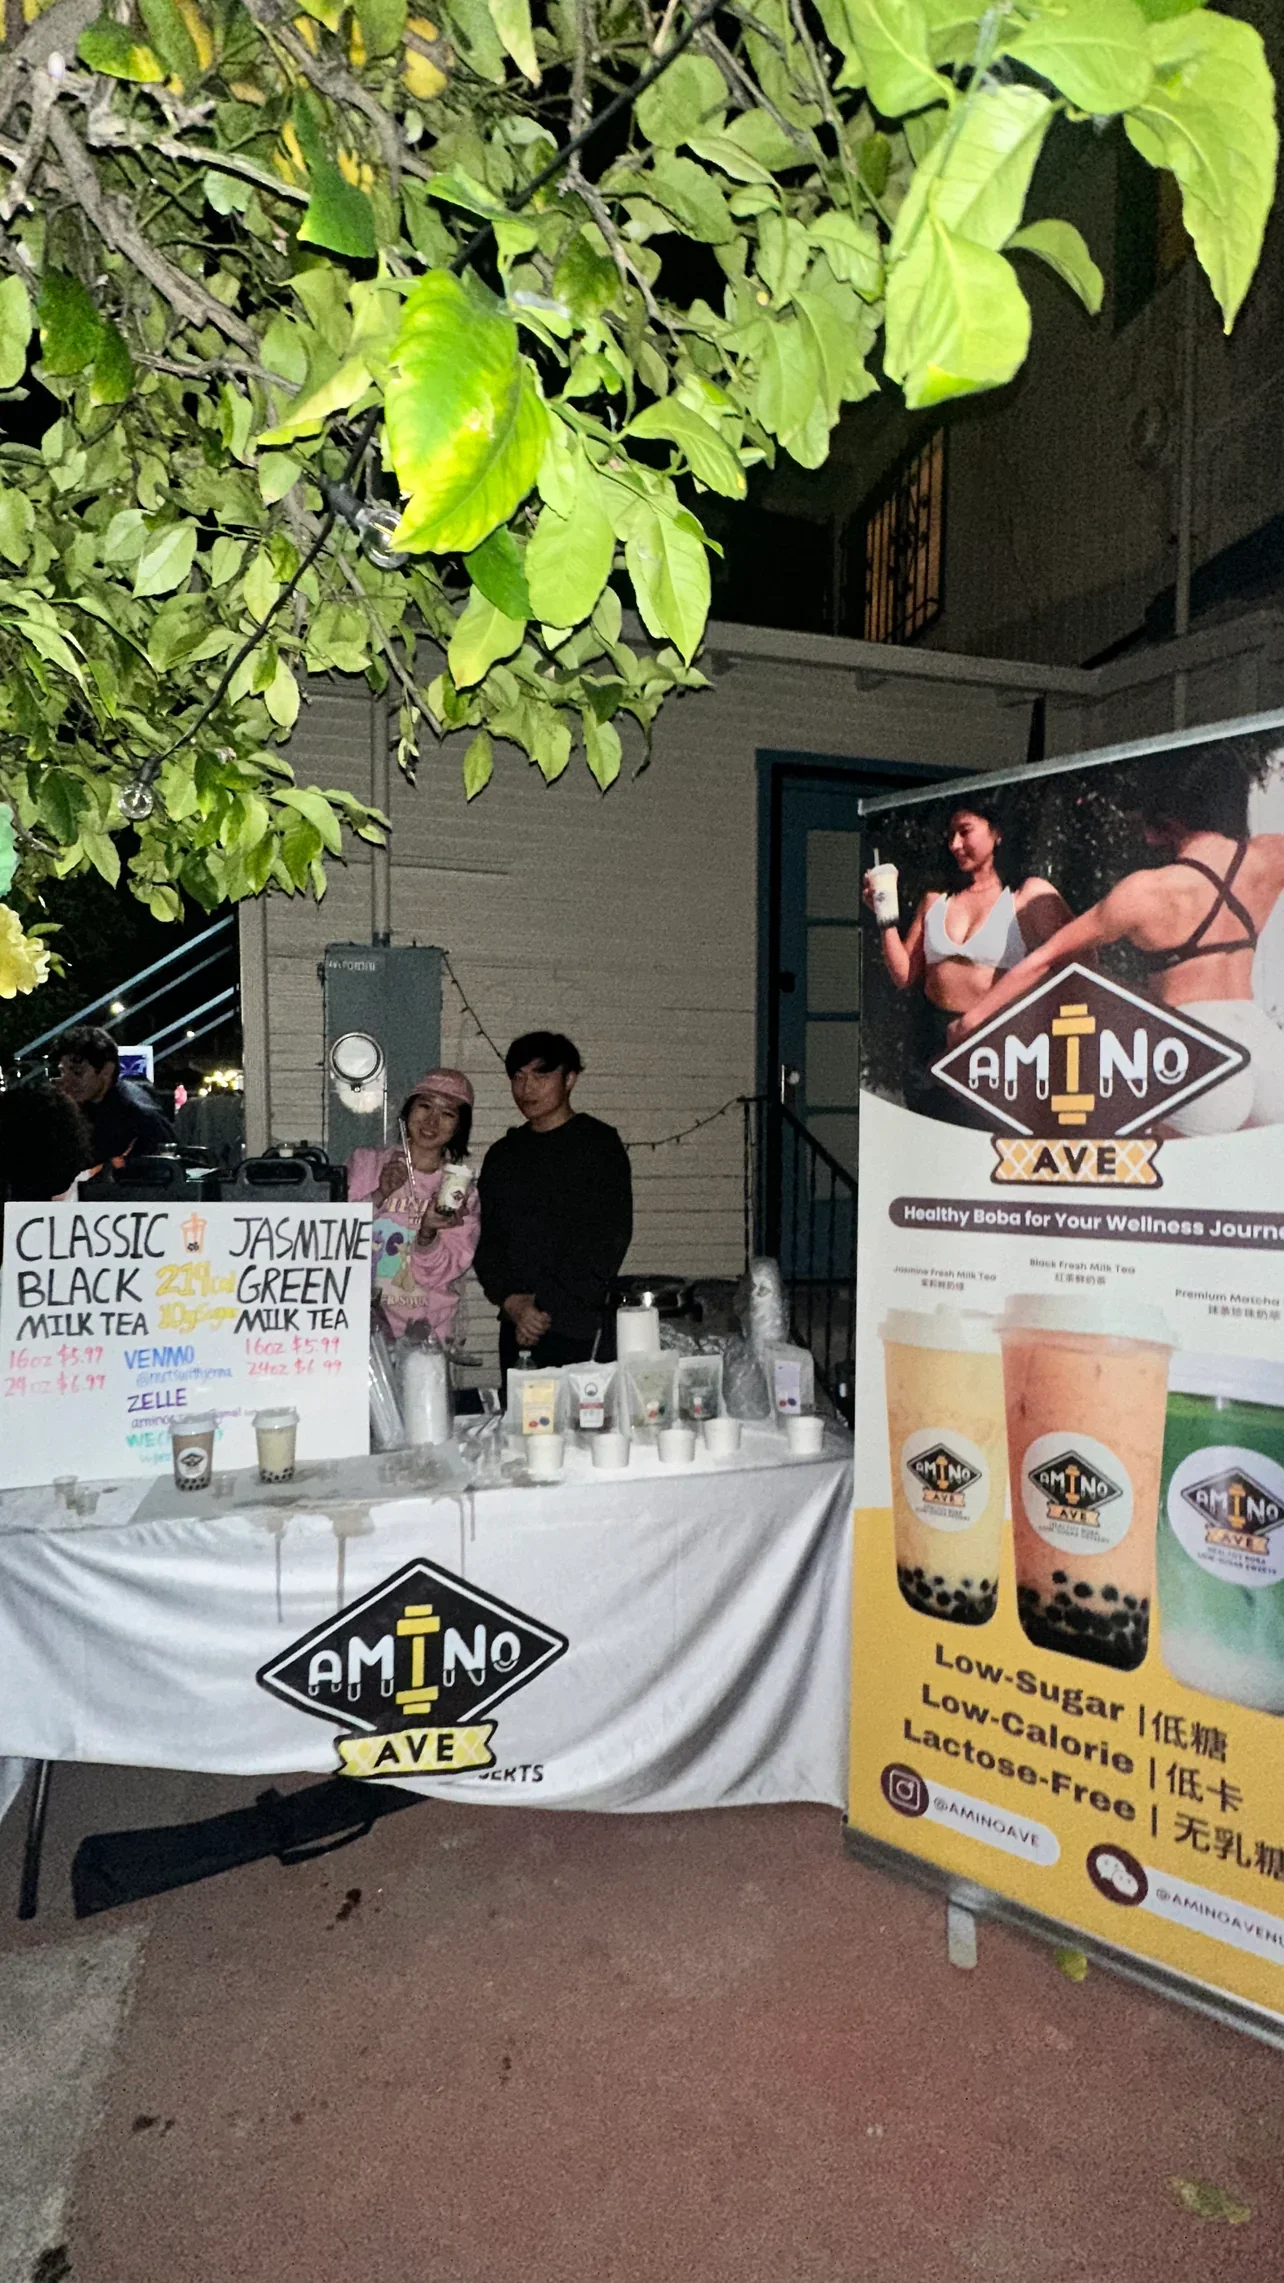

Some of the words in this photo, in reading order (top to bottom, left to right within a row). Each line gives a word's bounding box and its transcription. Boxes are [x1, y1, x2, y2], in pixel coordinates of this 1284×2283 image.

[968, 1003, 1190, 1125] AMINO
[1033, 1146, 1116, 1175] AVE
[16, 1212, 169, 1262] CLASSIC
[904, 1206, 970, 1227] Healthy
[974, 1209, 1021, 1226] Boba
[1025, 1211, 1051, 1228] for
[1054, 1212, 1102, 1231] Your
[1106, 1214, 1204, 1236] Wellness
[229, 1217, 372, 1261] JASMINE
[893, 1266, 929, 1276] Jasmine
[930, 1268, 955, 1278] Fresh
[957, 1271, 976, 1280] Milk
[979, 1272, 997, 1281] Tea
[1029, 1258, 1056, 1268] Black
[1059, 1261, 1087, 1270] Fresh
[1089, 1263, 1112, 1273] Milk
[1116, 1264, 1136, 1275] Tea
[17, 1267, 143, 1308] BLACK
[236, 1264, 352, 1305] GREEN
[1175, 1288, 1227, 1301] Premium
[1230, 1293, 1280, 1306] Matcha
[16, 1312, 94, 1341] MILK
[100, 1312, 149, 1336] TEA
[233, 1308, 300, 1335] MILK
[307, 1308, 349, 1331] TEA
[9, 1347, 53, 1369] 16oz
[124, 1345, 195, 1370] VENMO
[245, 1337, 287, 1356] 16oz
[127, 1388, 187, 1413] ZELLE
[1040, 1464, 1108, 1505] AMINO
[1060, 1511, 1087, 1521] AVE
[1196, 1483, 1279, 1528] AMINO
[1222, 1534, 1254, 1548] AVE
[308, 1604, 521, 1714] AMINO
[934, 1642, 1125, 1723] Low-Sugar
[1151, 1709, 1228, 1763] 低糖
[373, 1733, 455, 1767] AVE
[921, 1683, 1134, 1775] Low-Calorie
[1166, 1761, 1244, 1814] 低卡
[903, 1718, 1136, 1822] Lactose-Free
[933, 1796, 1041, 1849] @AMINOAVE
